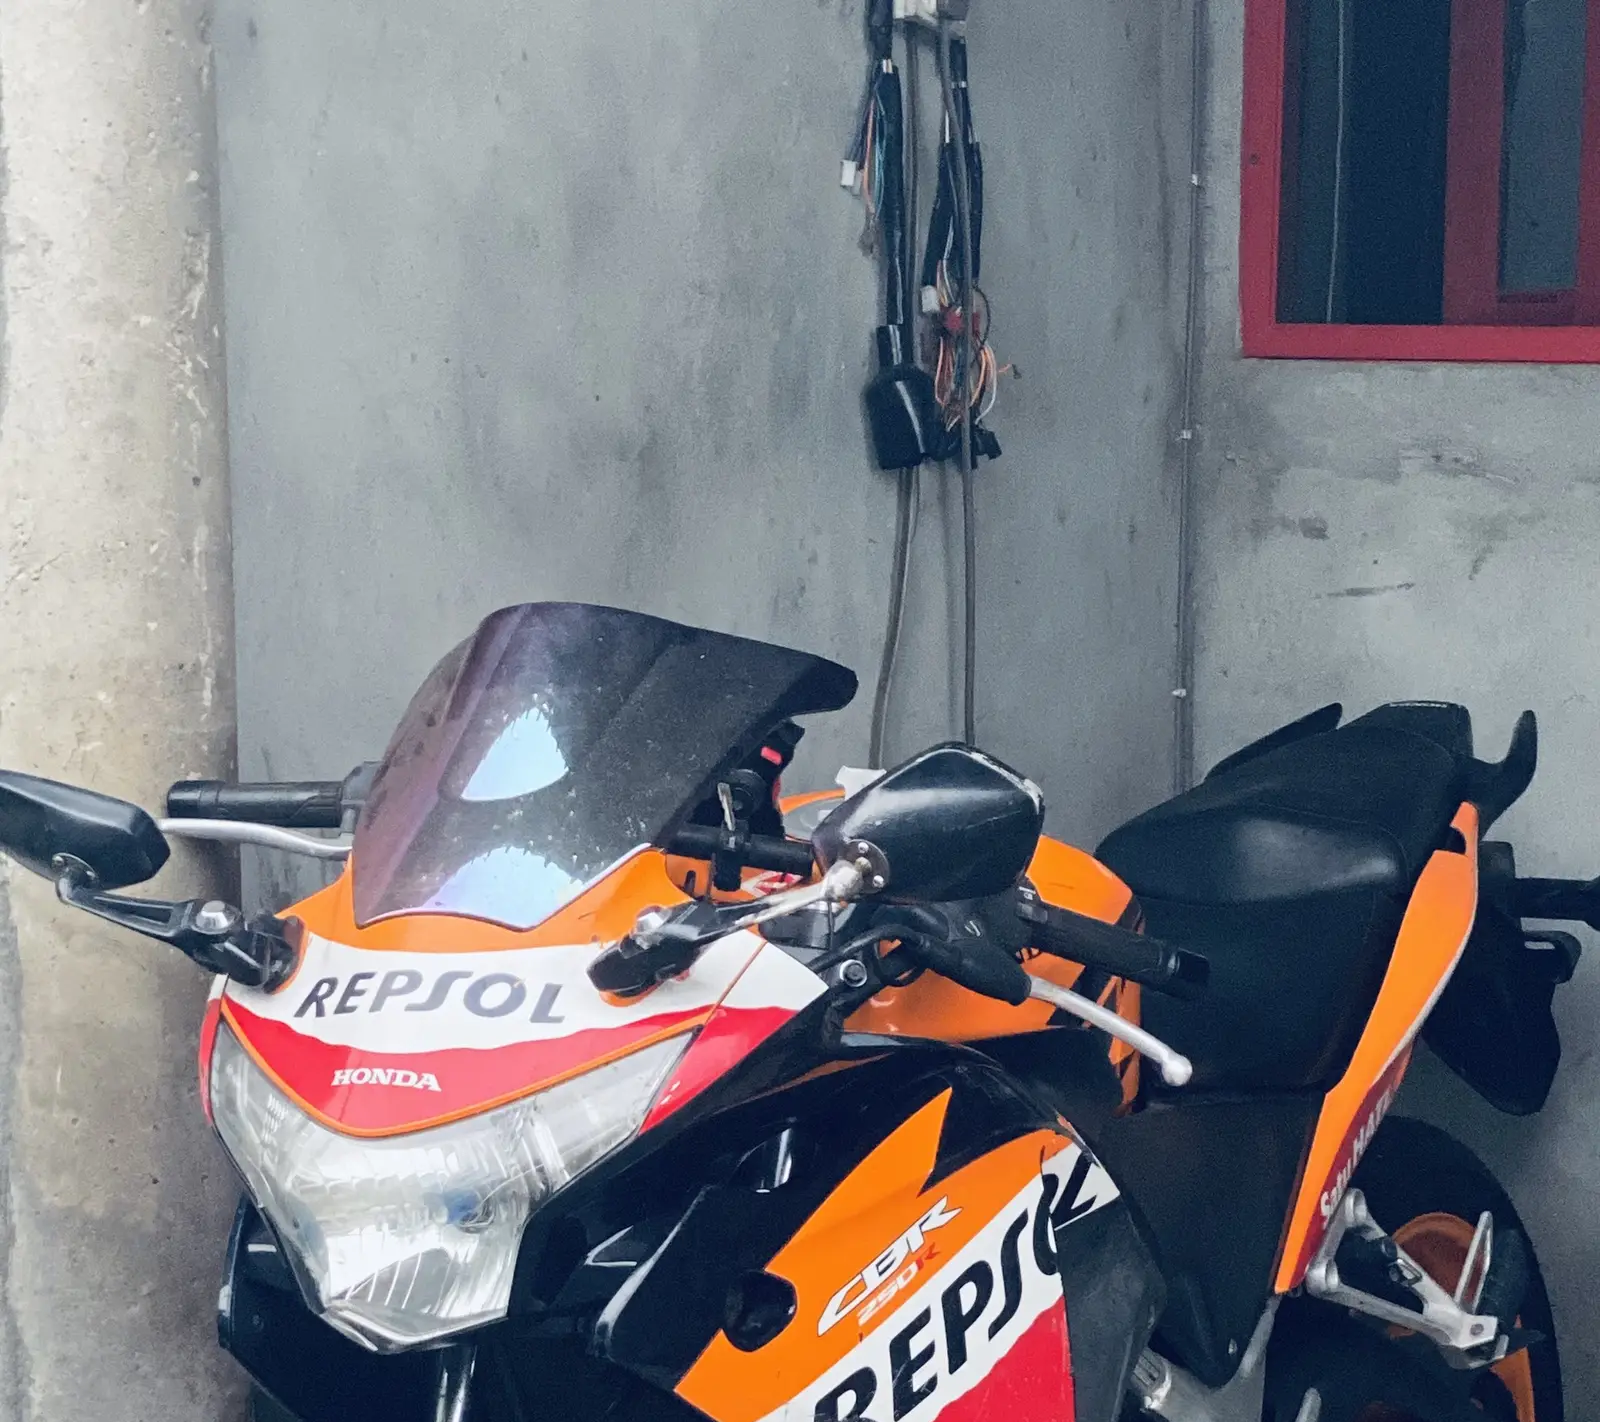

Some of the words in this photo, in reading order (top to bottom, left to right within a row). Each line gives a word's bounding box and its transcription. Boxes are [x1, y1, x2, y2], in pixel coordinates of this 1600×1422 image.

[293, 969, 566, 1024] REPSOL
[330, 1067, 442, 1092] HONDA
[816, 1194, 964, 1338] CBR
[856, 1241, 941, 1327] 250R
